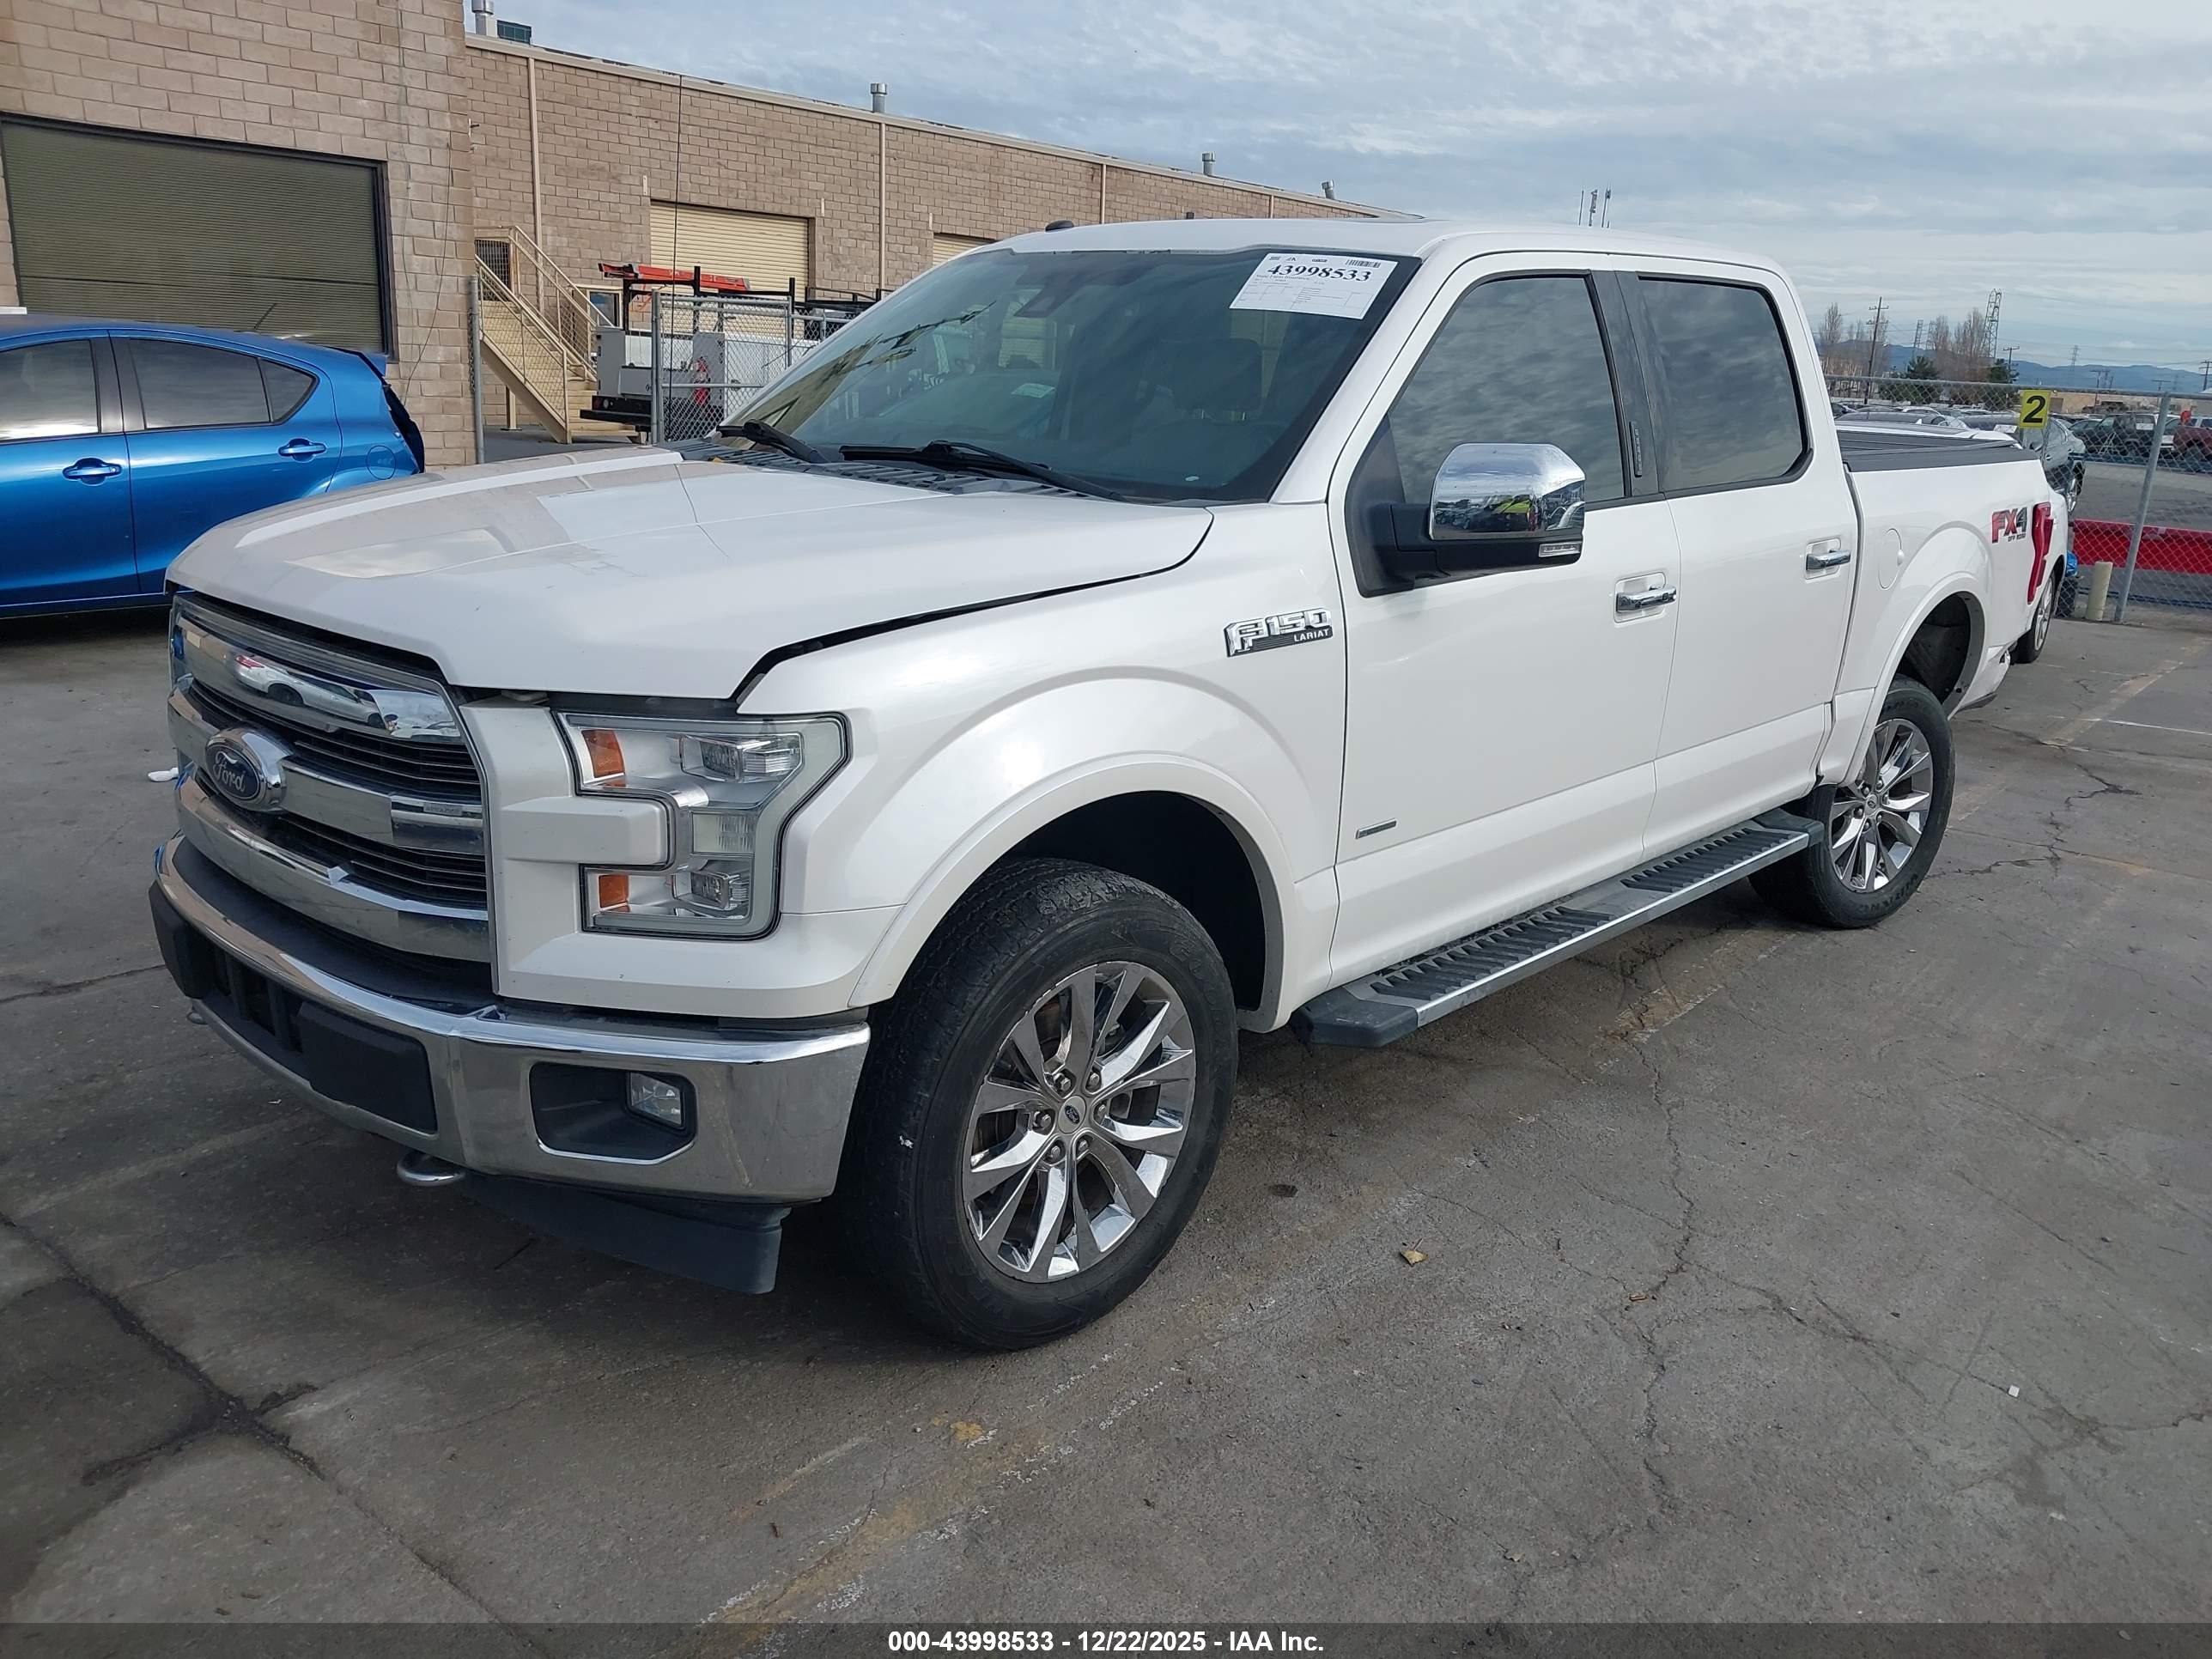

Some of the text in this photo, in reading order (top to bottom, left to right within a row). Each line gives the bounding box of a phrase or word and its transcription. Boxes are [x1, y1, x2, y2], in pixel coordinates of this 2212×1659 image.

[1267, 264, 1371, 282] 43998533
[2022, 395, 2046, 423] 2
[1991, 507, 2027, 544] FX4
[1293, 628, 1330, 642] LARIAT
[213, 750, 246, 792] Ford
